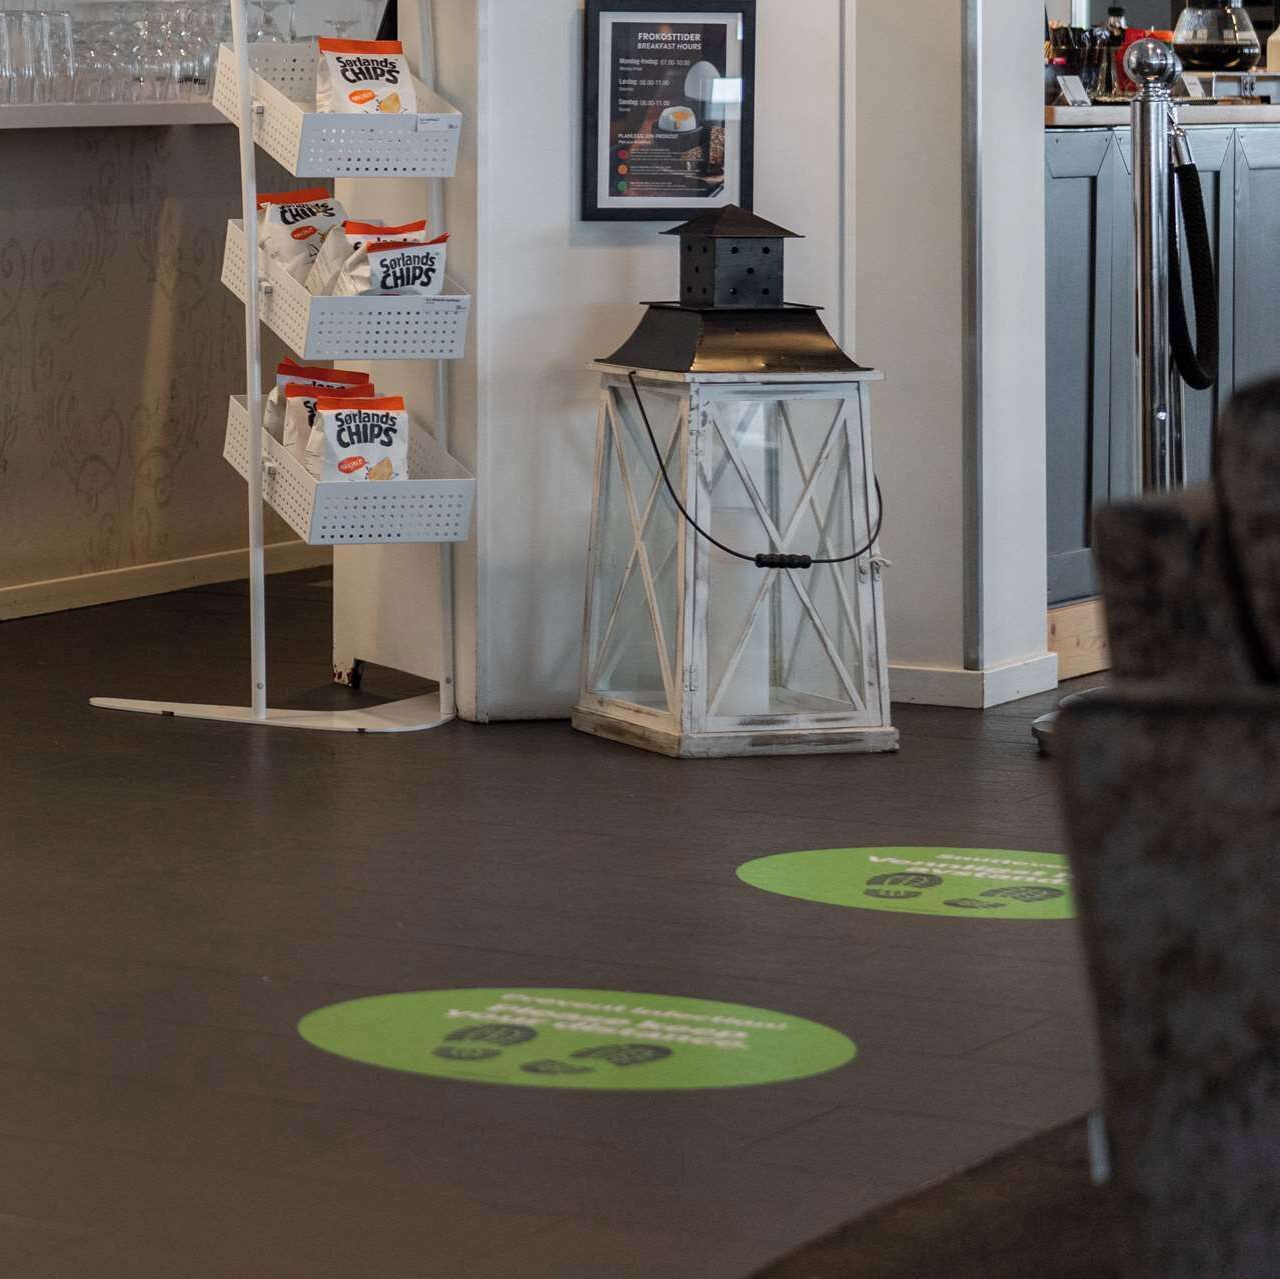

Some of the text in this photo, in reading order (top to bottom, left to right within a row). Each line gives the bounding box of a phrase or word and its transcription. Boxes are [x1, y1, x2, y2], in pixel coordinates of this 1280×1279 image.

[638, 32, 701, 41] FROKOSTTIDER
[637, 42, 676, 50] BREAKFAST
[335, 55, 398, 71] Sørlands
[340, 66, 401, 85] CHIPS
[379, 251, 437, 272] Sørlands
[379, 265, 437, 290] CHIPS
[335, 410, 399, 428] Sørlands
[336, 423, 399, 449] CHIPS
